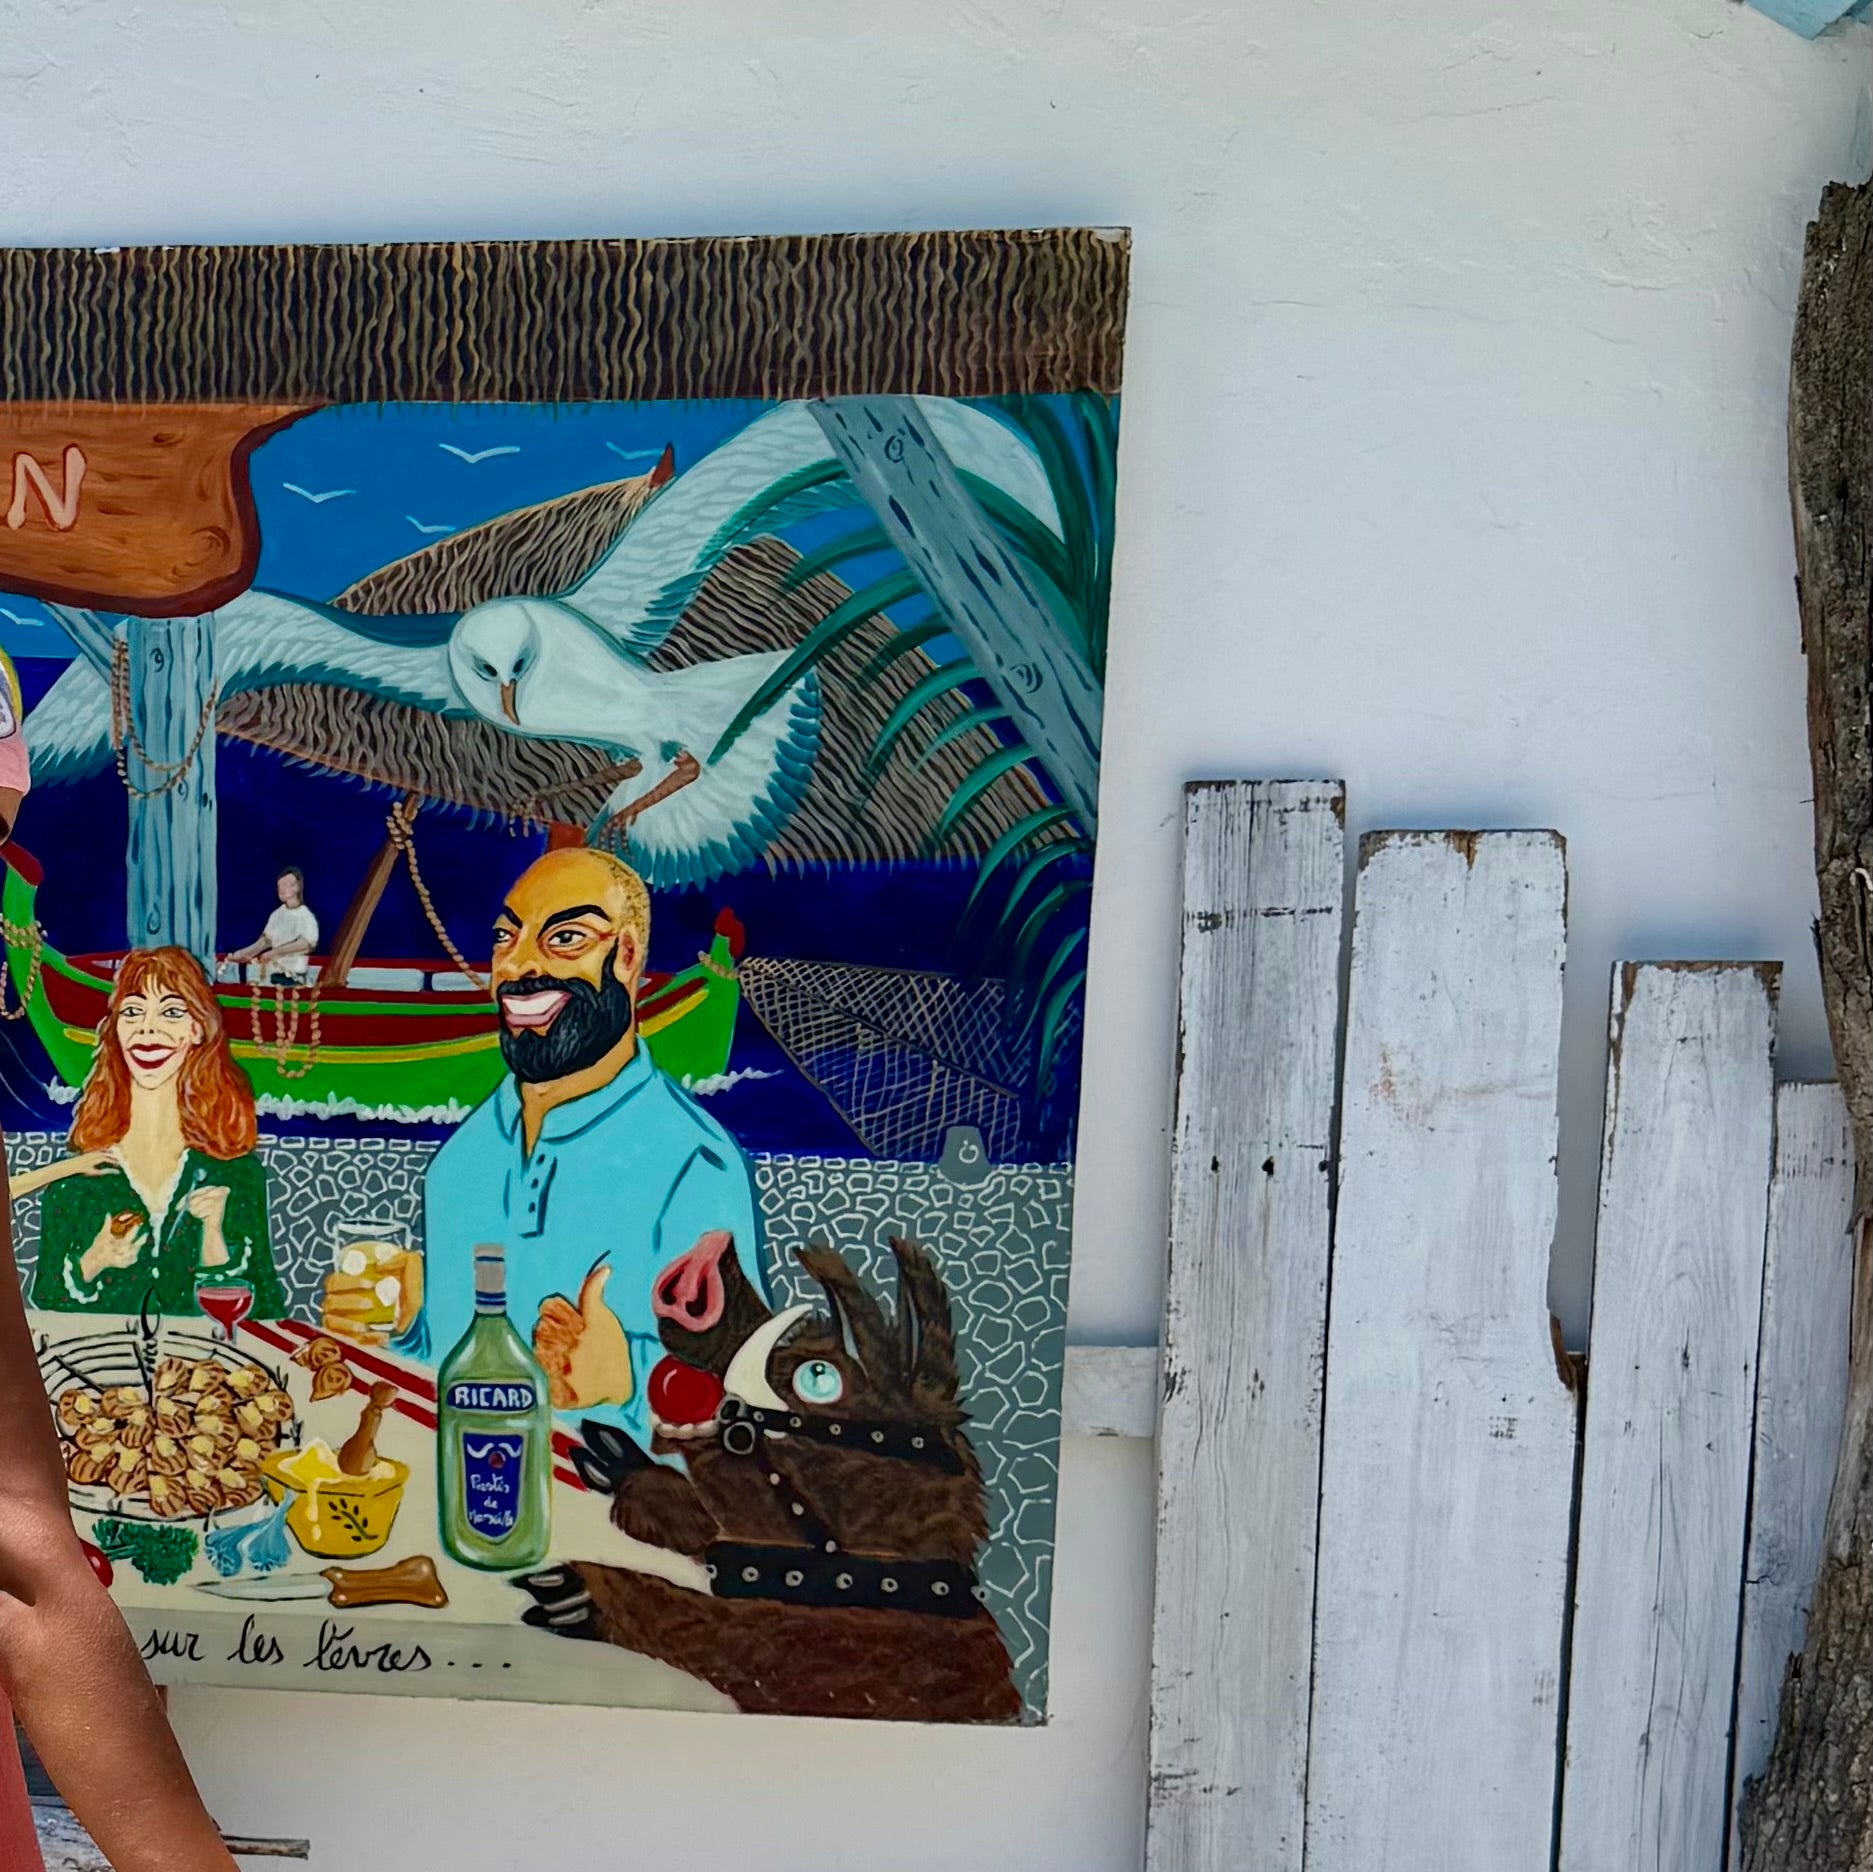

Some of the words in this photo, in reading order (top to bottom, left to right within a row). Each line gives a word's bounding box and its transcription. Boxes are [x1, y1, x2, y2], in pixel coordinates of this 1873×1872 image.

[455, 1386, 533, 1408] RICARD
[470, 1473, 510, 1494] Pastis
[483, 1496, 499, 1509] de
[140, 1628, 206, 1661] sur
[226, 1613, 284, 1664] les
